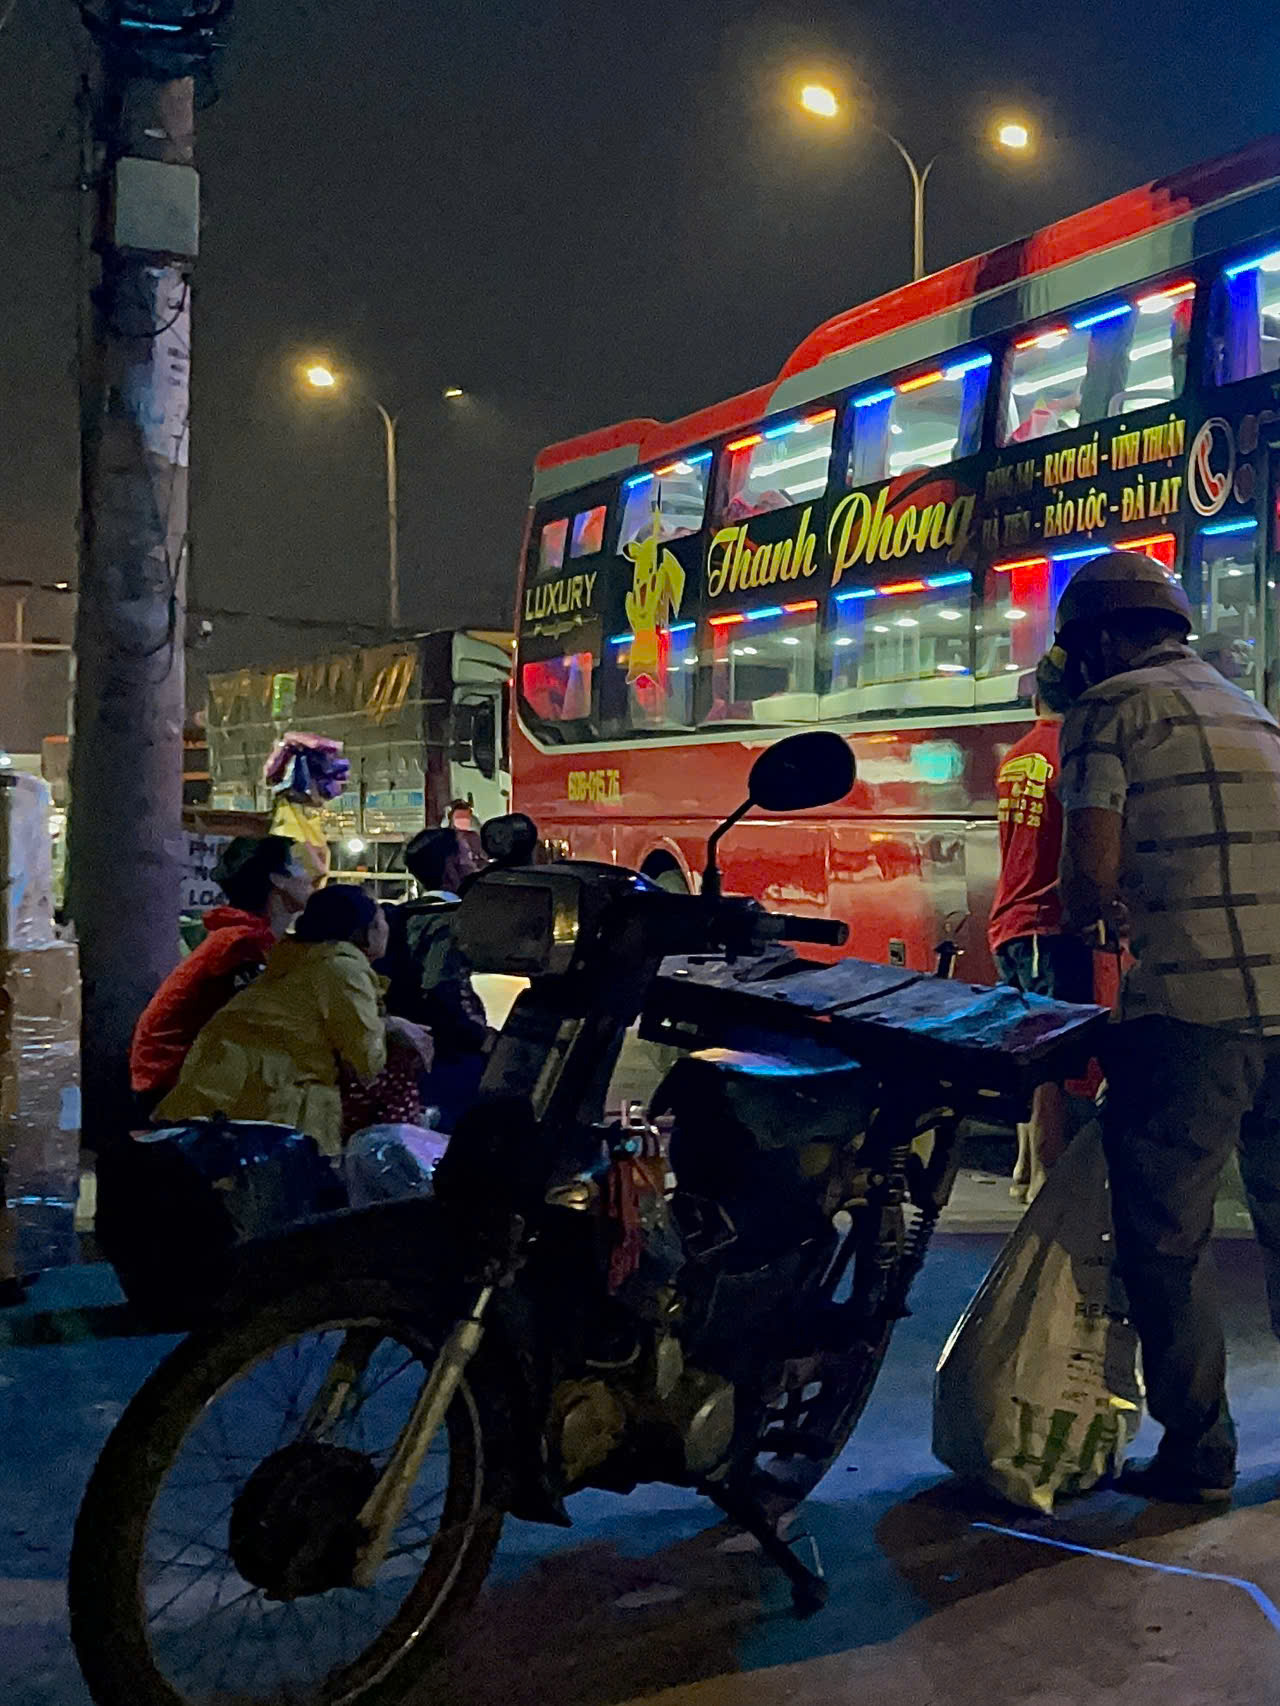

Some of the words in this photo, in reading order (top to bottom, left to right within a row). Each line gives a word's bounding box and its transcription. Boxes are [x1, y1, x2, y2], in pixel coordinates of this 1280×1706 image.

[1077, 431, 1099, 480] GIÁ
[1076, 487, 1108, 539] LỘC
[1121, 473, 1147, 523] ĐÀ
[1148, 476, 1183, 525] LẠT
[707, 506, 819, 598] Thanh
[826, 485, 978, 588] Phong
[525, 571, 598, 622] LUXURY
